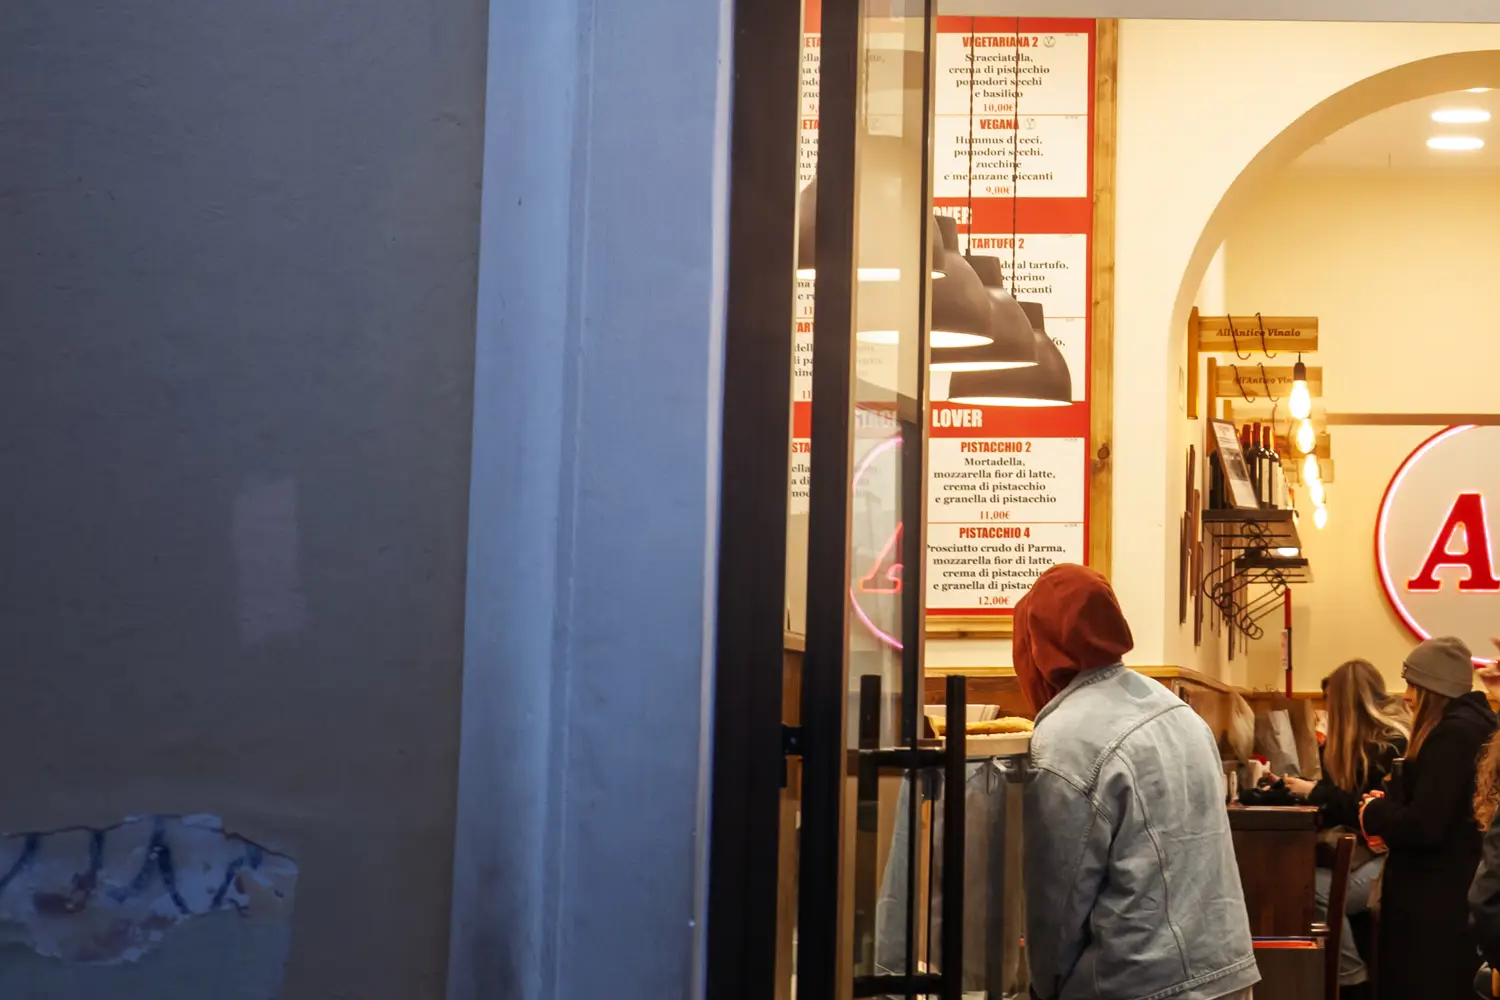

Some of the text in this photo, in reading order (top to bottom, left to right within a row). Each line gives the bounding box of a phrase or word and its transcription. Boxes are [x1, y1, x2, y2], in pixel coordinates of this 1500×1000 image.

[1032, 36, 1038, 48] 2
[965, 53, 1033, 63] Sracciatella,
[983, 65, 994, 74] di
[983, 89, 1024, 98] basilico
[979, 118, 1020, 130] VEGANA
[955, 135, 1004, 144] Hummus
[1006, 135, 1016, 144] d
[954, 148, 1006, 158] pomodori
[952, 172, 1009, 181] meanzane
[971, 238, 1025, 249] TARTUFO 2
[1016, 260, 1026, 269] al
[1029, 260, 1069, 270] tartufo,
[1216, 328, 1266, 337] AllAntico
[932, 408, 983, 428] LOVER
[960, 441, 1032, 453] PISTACCHIO 2
[964, 457, 1026, 467] Mortadella,
[933, 469, 1056, 479] mozzarella fior di latte,
[979, 481, 990, 491] di
[992, 481, 1046, 493] pistacchio
[934, 494, 1057, 505] e granella di pistacchio
[980, 510, 1011, 520] 11,00€
[959, 527, 1031, 539] PISTACCHIO 4
[980, 544, 1012, 553] crudo
[1014, 544, 1025, 553] di
[1027, 544, 1066, 554] Parma,
[933, 556, 1055, 566] mozzarella fior di latte,
[942, 570, 976, 578] crema
[978, 568, 989, 578] di
[941, 580, 985, 592] granella
[987, 580, 998, 590] di
[1001, 580, 1033, 592] pistac
[978, 596, 1010, 606] 12,00€
